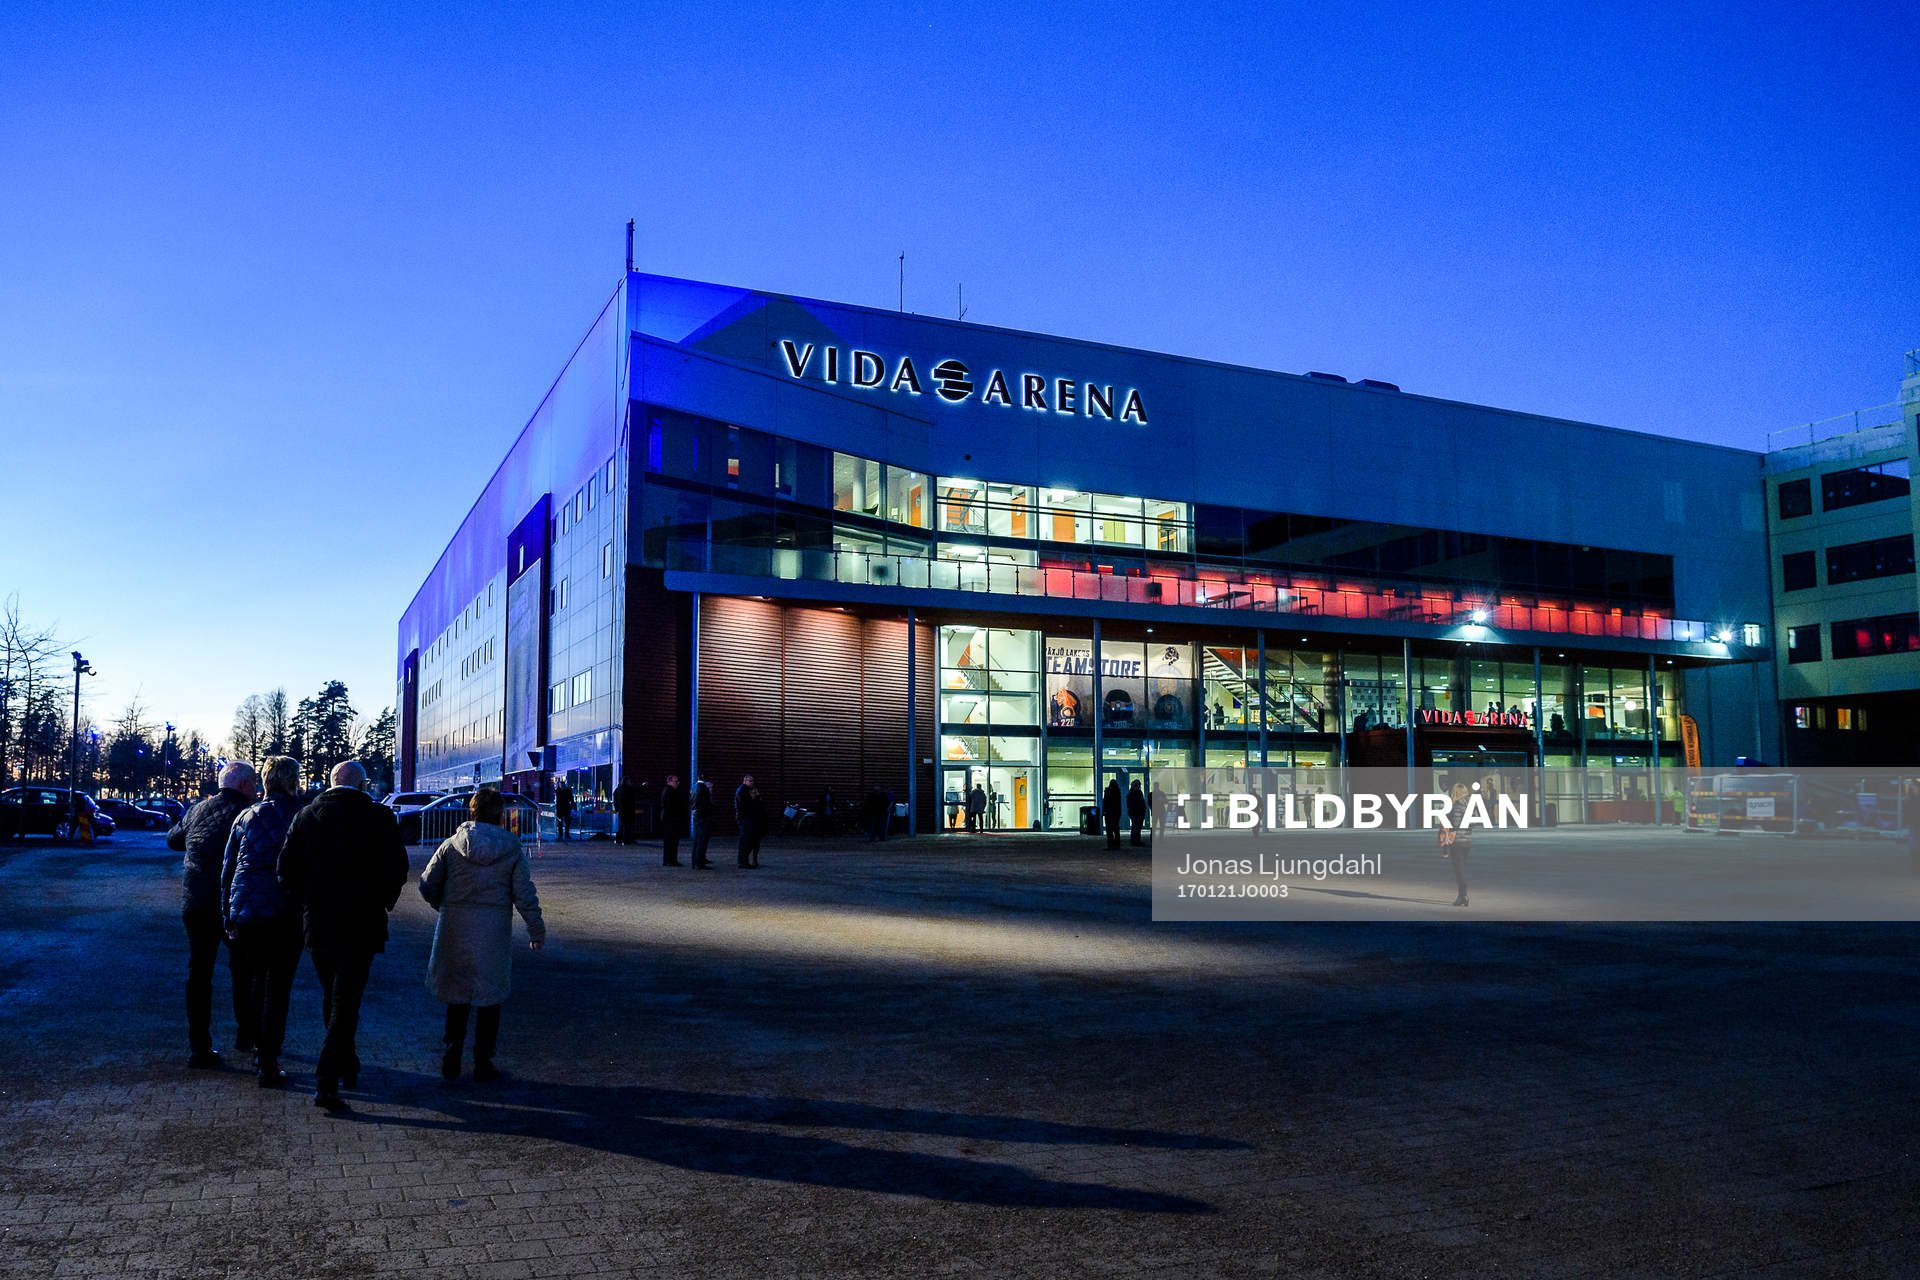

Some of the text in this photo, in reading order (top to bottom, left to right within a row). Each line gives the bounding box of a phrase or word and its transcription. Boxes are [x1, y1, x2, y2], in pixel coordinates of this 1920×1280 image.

[781, 339, 1149, 426] VIDA ARENA
[1422, 709, 1529, 726] VIDA ARENA
